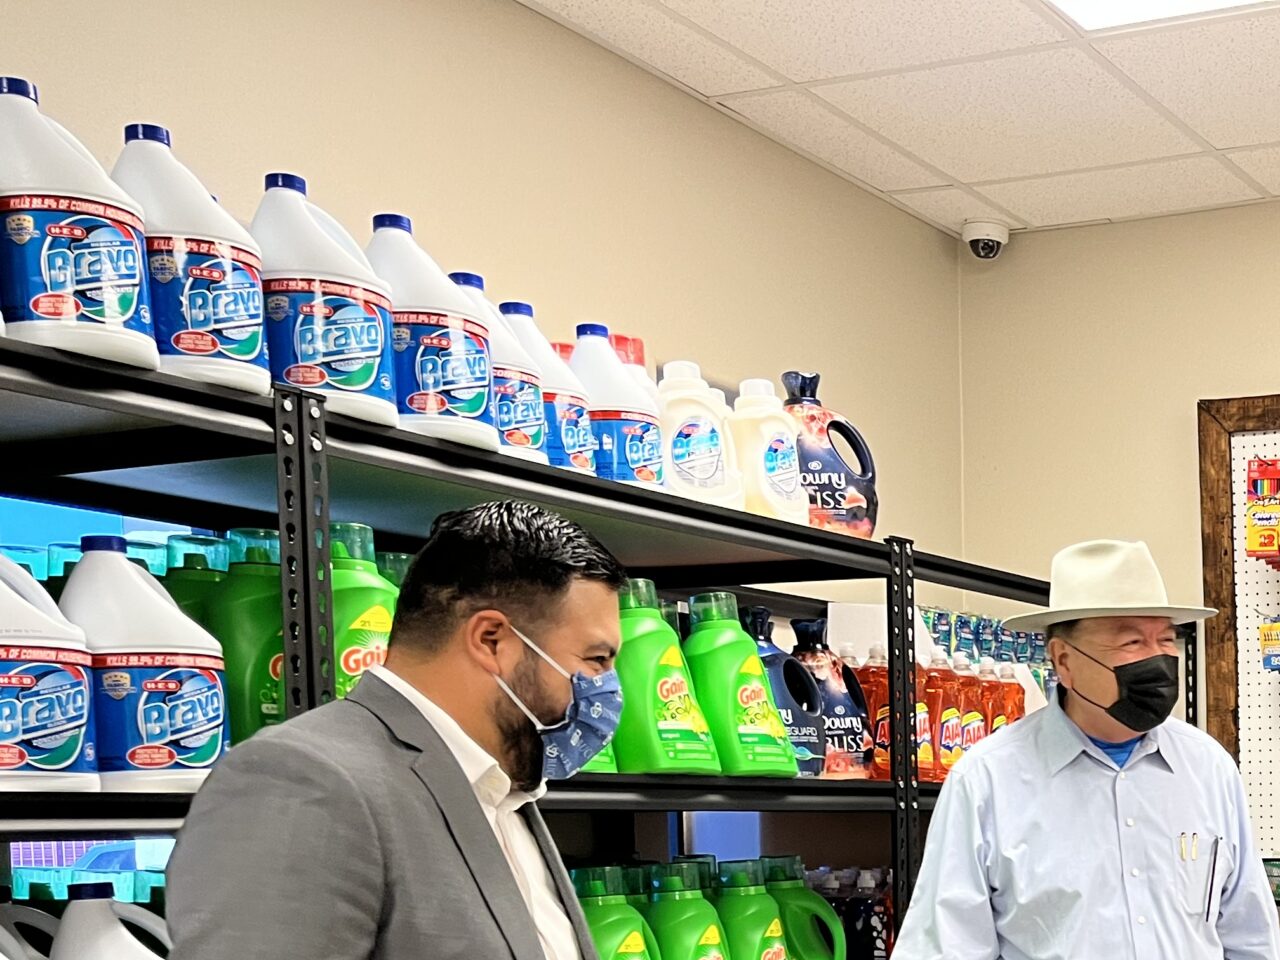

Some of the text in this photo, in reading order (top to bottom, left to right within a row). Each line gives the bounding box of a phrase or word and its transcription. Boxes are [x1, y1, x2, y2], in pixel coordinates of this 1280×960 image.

[46, 248, 138, 293] Bravo
[188, 289, 262, 330] Bravo
[299, 324, 380, 364] Bravo
[420, 356, 487, 391] Bravo
[800, 472, 847, 489] owny
[1259, 534, 1275, 547] 12
[143, 690, 221, 745] Bravo
